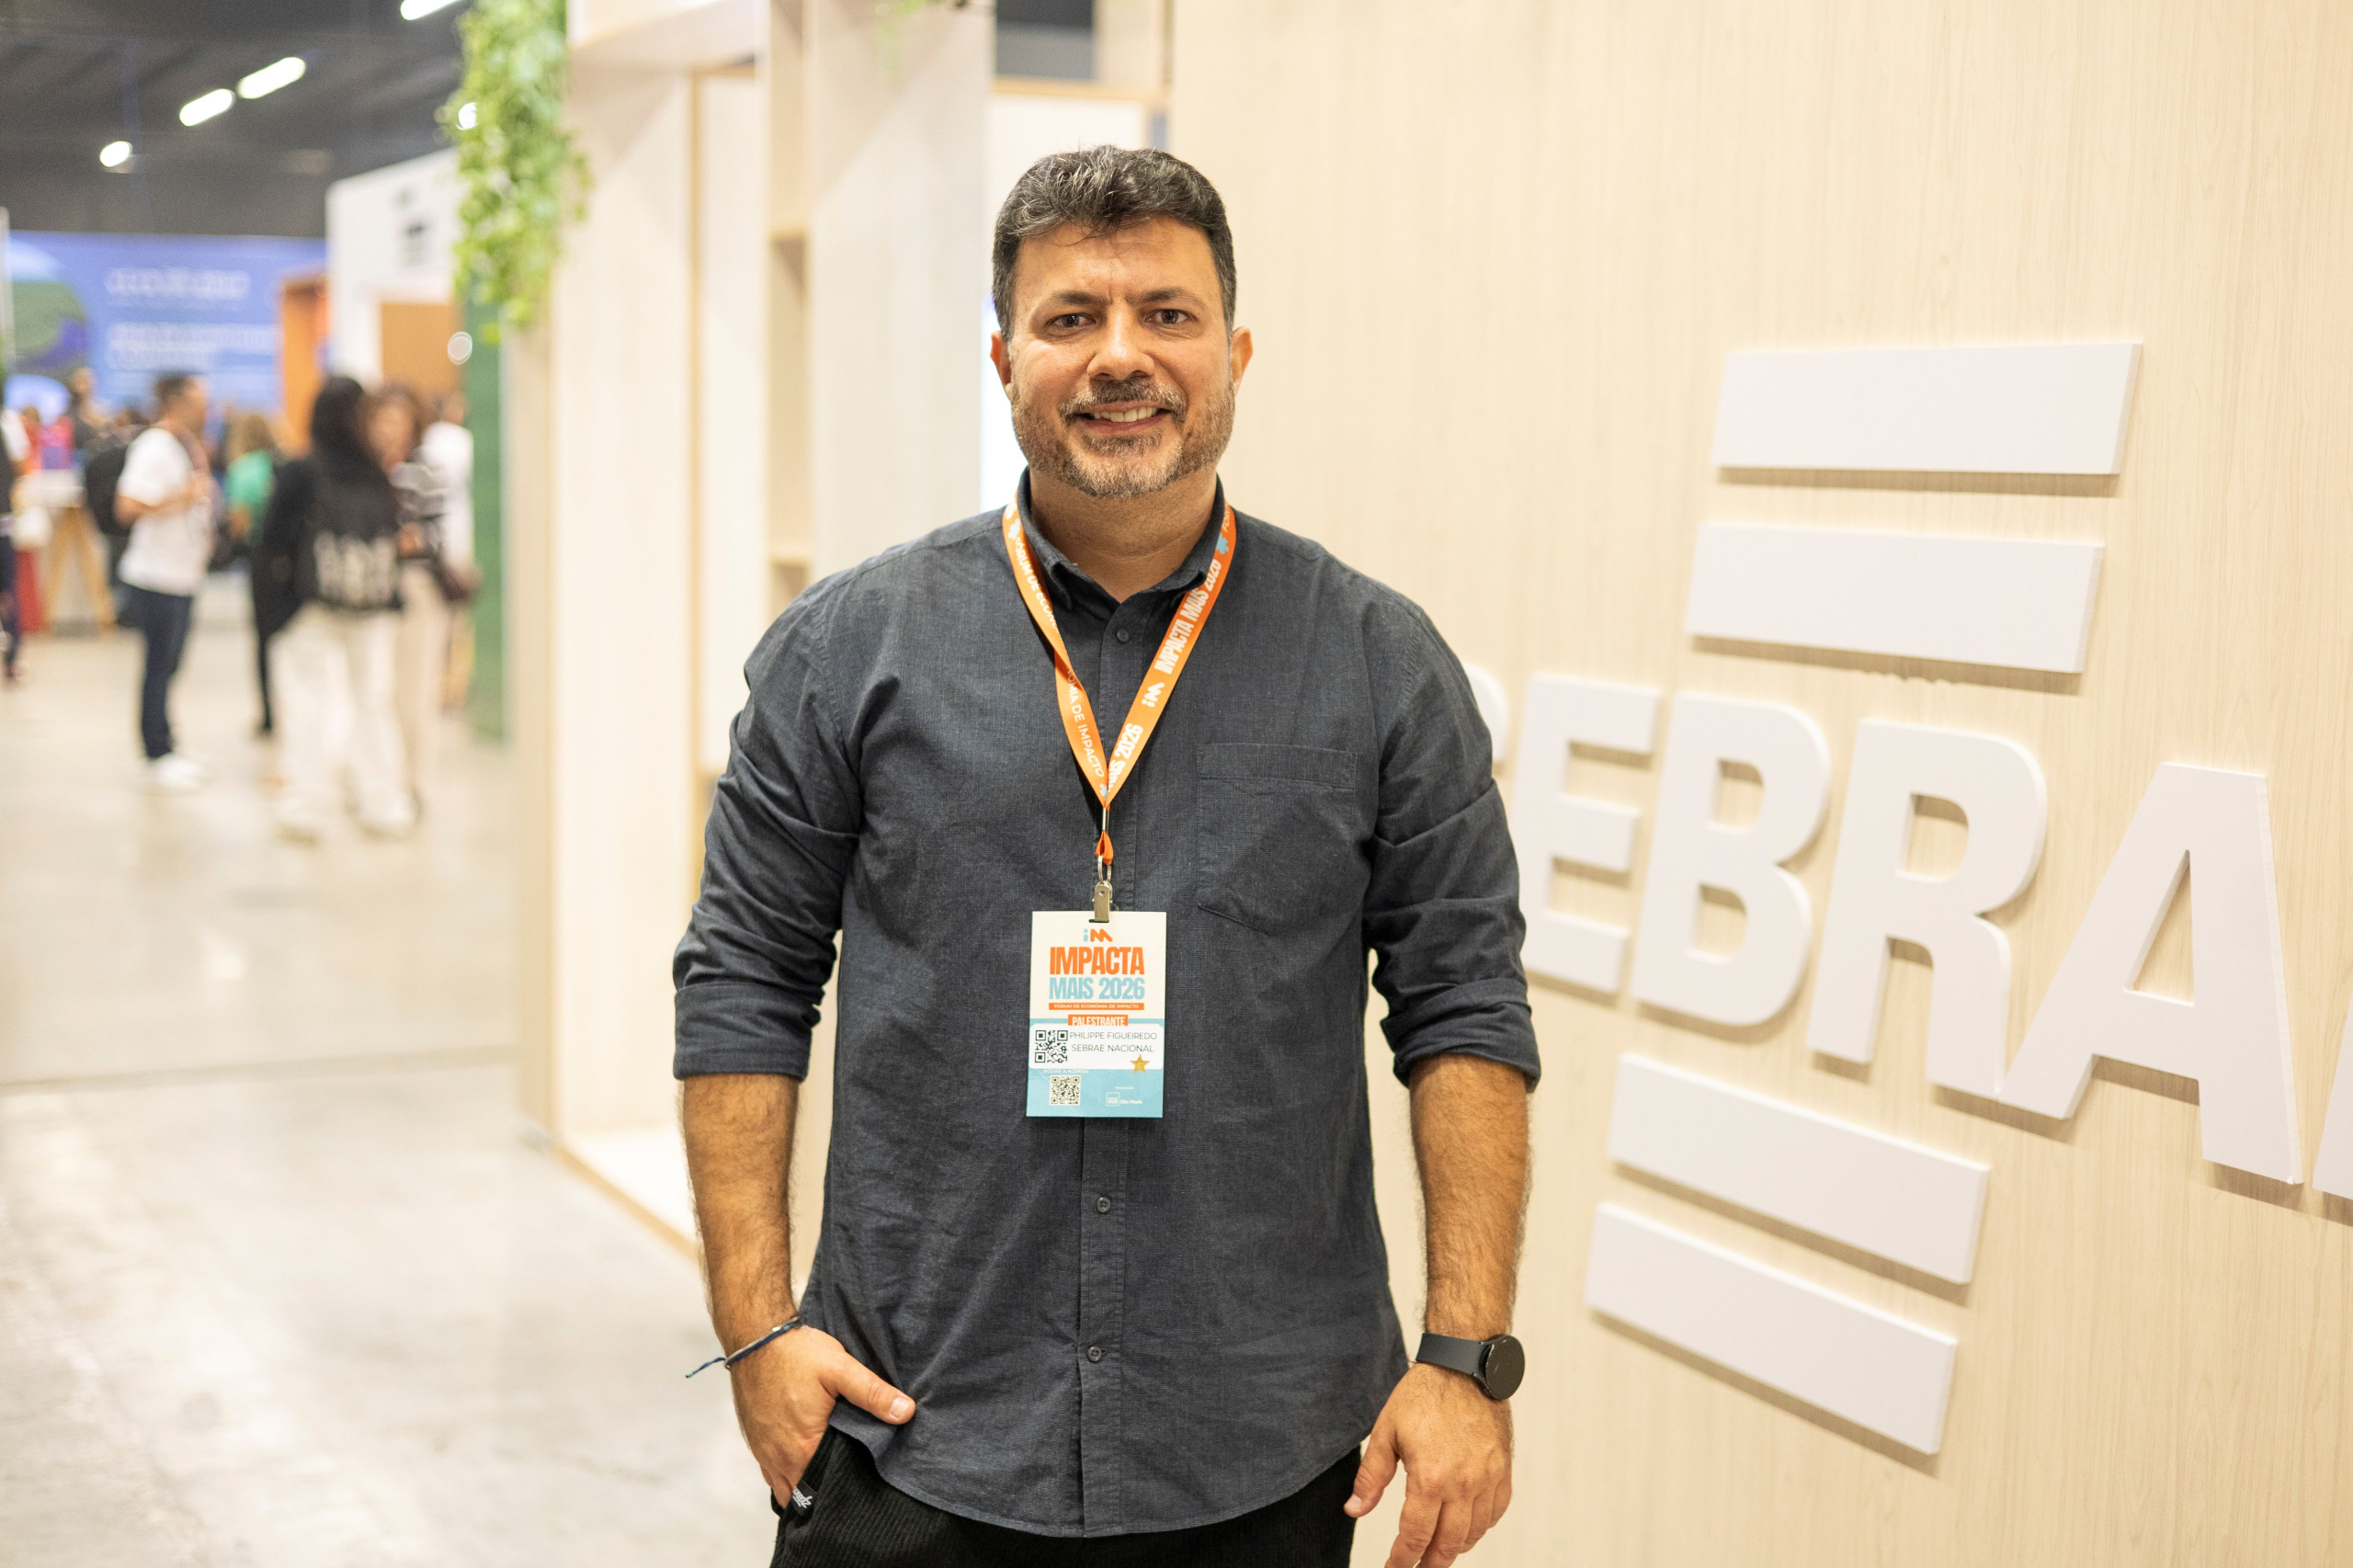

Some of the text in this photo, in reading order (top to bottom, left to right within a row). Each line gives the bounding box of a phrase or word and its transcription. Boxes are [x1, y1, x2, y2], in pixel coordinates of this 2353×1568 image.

[1027, 575, 1042, 591] DE
[1154, 619, 1194, 674] IMPACTA
[1180, 587, 1210, 621] MAIS
[1071, 703, 1086, 722] DE
[1077, 723, 1105, 778] IMPACTO
[1114, 722, 1143, 759] 2026
[1469, 664, 2353, 1199] EBRA
[1050, 947, 1145, 975] IMPACTA
[1049, 977, 1145, 1000] MAIS 2026
[1072, 1016, 1126, 1026] PALESTRANTE
[1069, 1031, 1157, 1040] PHILIPPE FIGUEIREDO
[1072, 1044, 1154, 1052] SEBRAE NACIONAL
